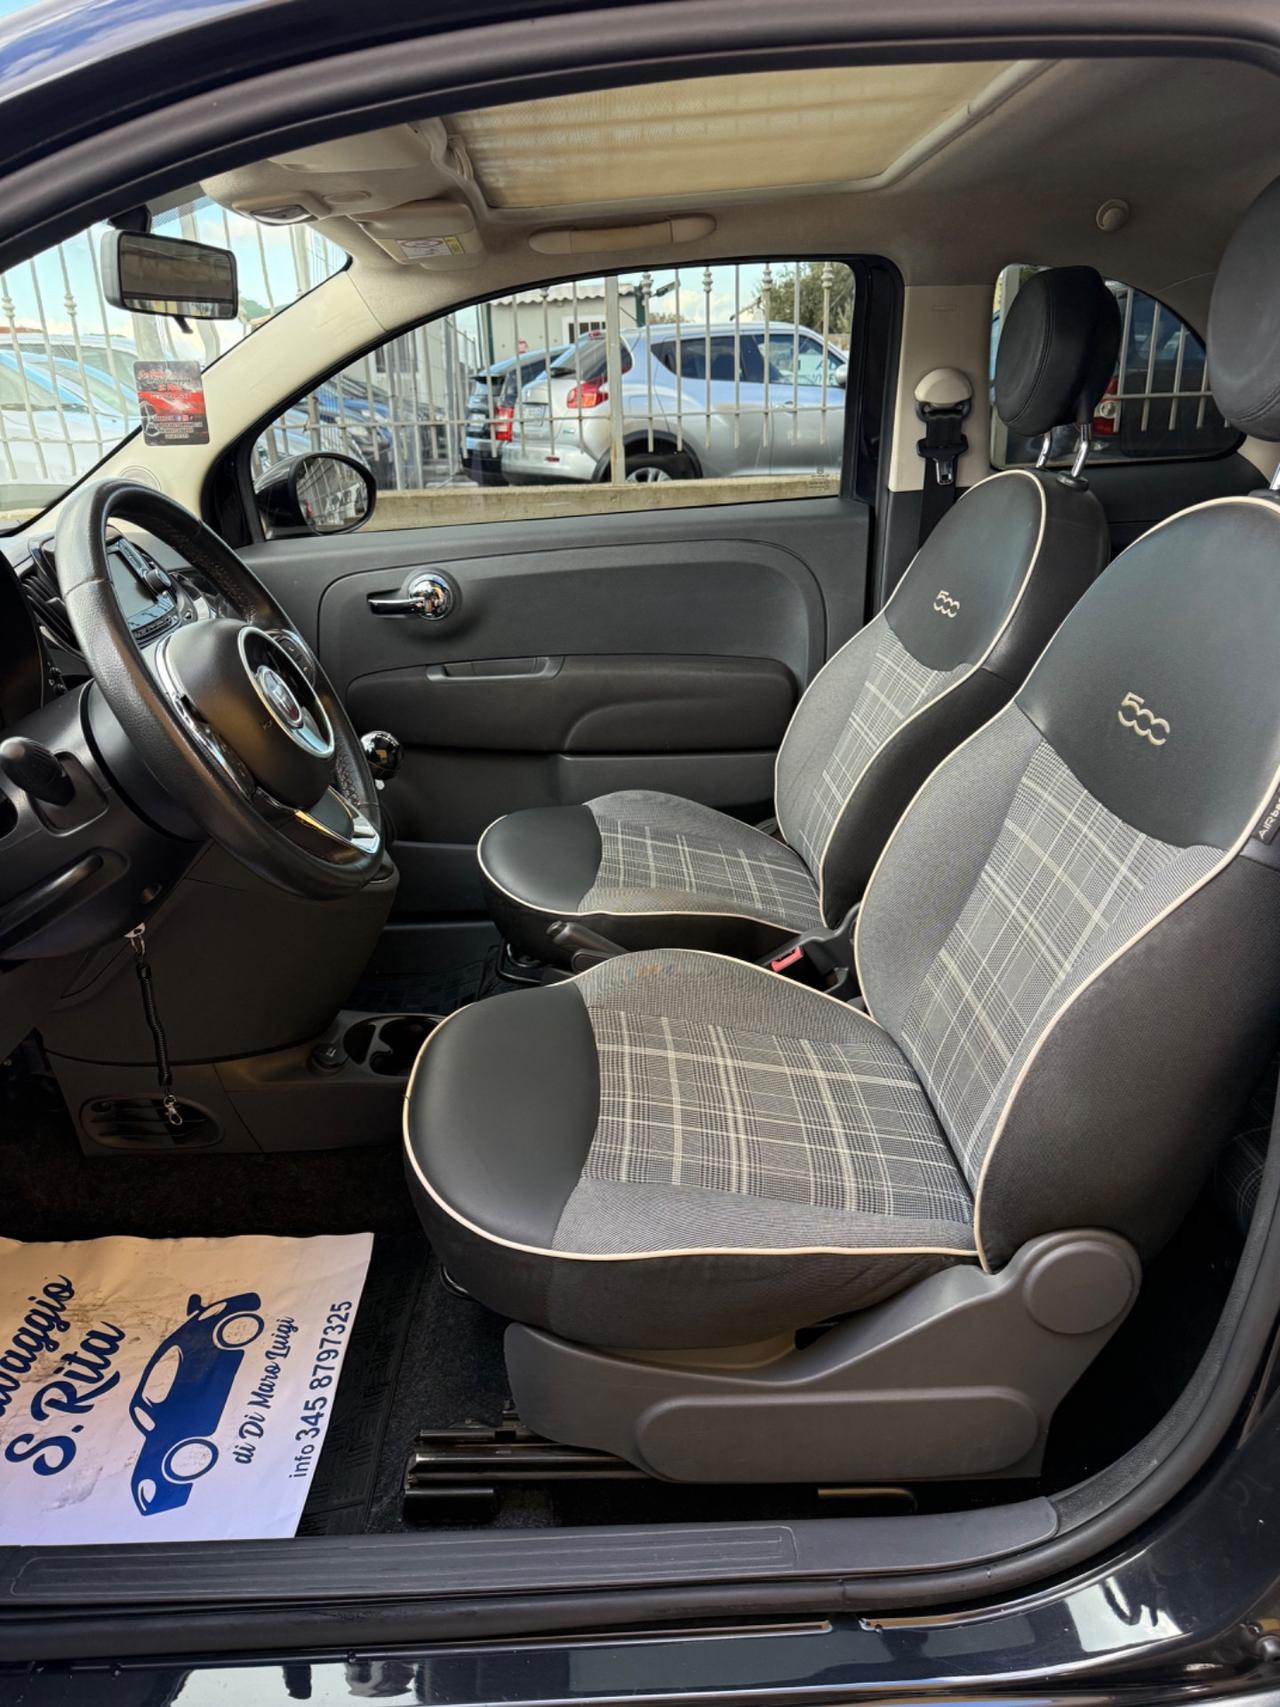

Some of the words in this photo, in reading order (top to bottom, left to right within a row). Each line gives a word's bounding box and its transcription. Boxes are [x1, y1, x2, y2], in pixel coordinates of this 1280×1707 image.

[933, 590, 960, 618] 500
[1118, 692, 1170, 745] 500
[265, 1316, 299, 1359] Luigi
[309, 1301, 353, 1390] 8797325
[247, 1361, 281, 1409] Maro
[238, 1411, 266, 1439] Di
[295, 1396, 327, 1441] 345
[232, 1442, 256, 1465] di
[289, 1444, 315, 1478] info
